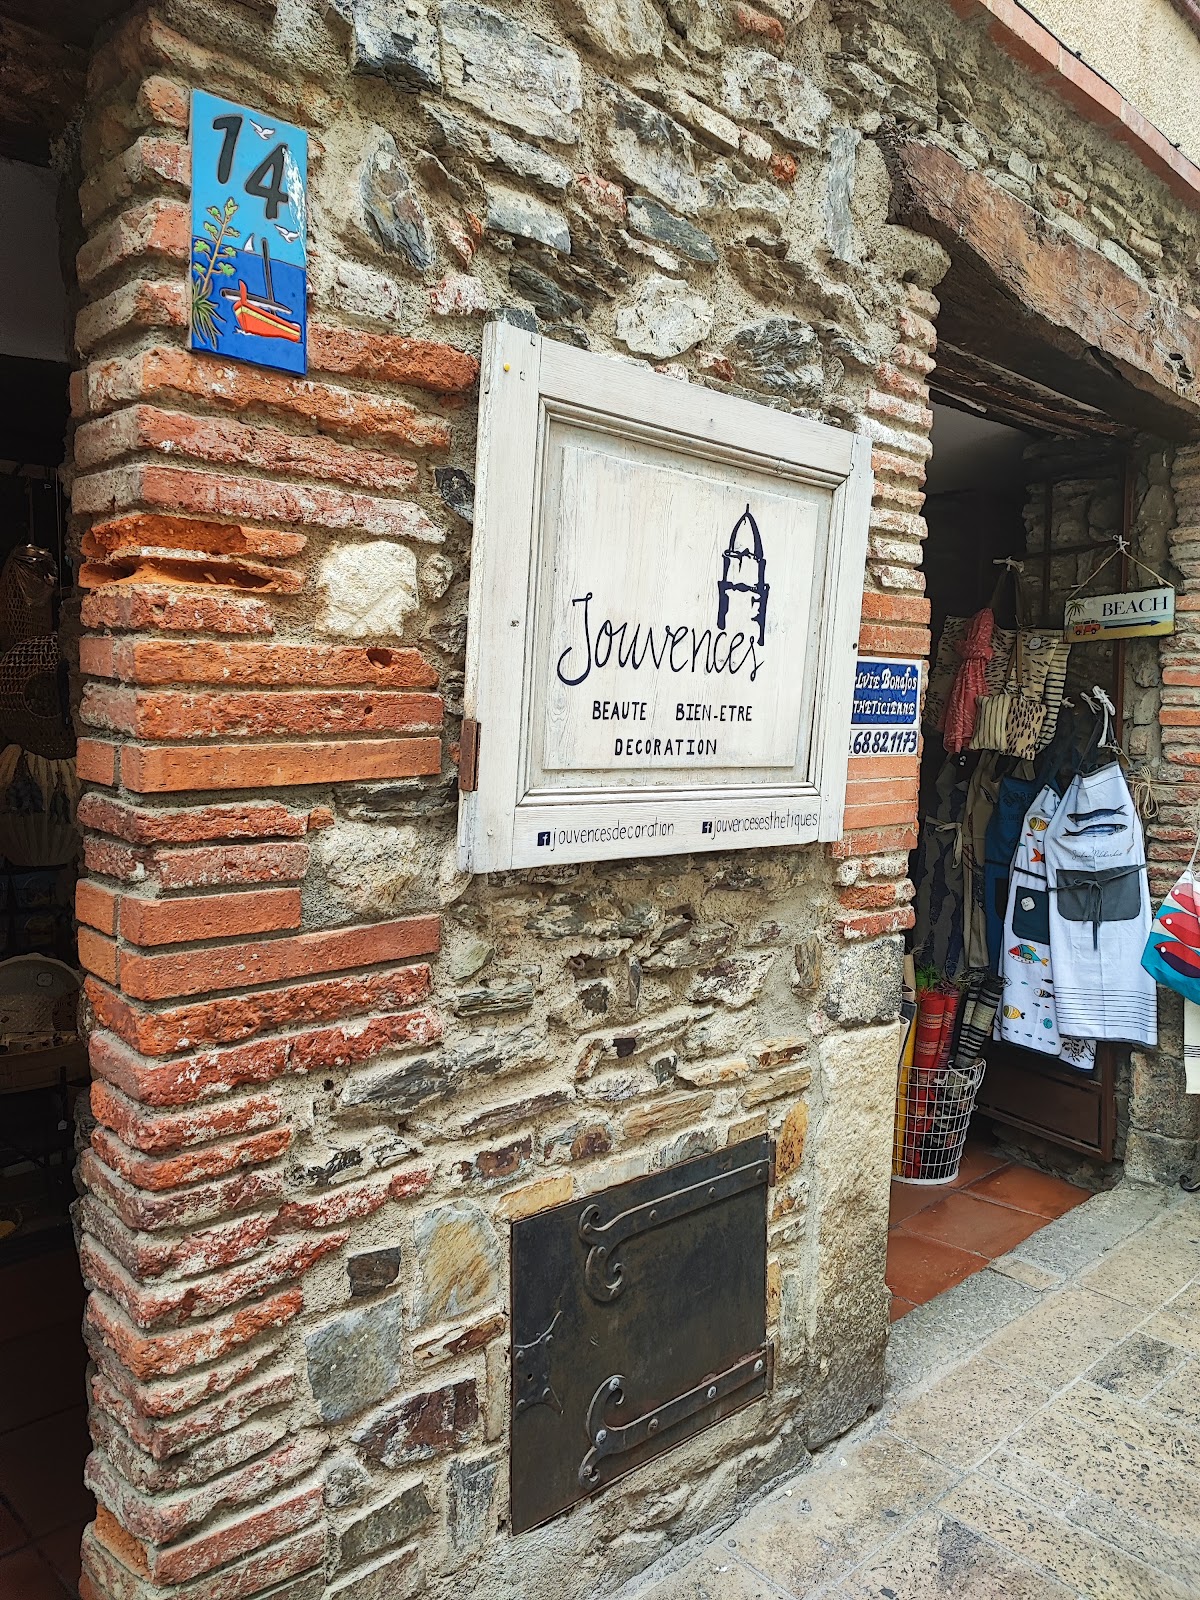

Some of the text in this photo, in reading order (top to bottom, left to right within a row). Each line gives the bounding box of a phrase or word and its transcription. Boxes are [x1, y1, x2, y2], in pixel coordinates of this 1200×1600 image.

[212, 114, 289, 220] 14
[1101, 596, 1168, 617] BEACH
[556, 591, 765, 686] Jouvences
[855, 671, 880, 689] LVIE
[592, 700, 753, 722] BEAUTE BIEN-ETRE
[853, 698, 915, 715] THETICIENNE
[614, 738, 717, 756] DECORATION
[550, 817, 675, 851] jouvencesdecoration
[711, 809, 818, 840] jouvencesesthetiques
